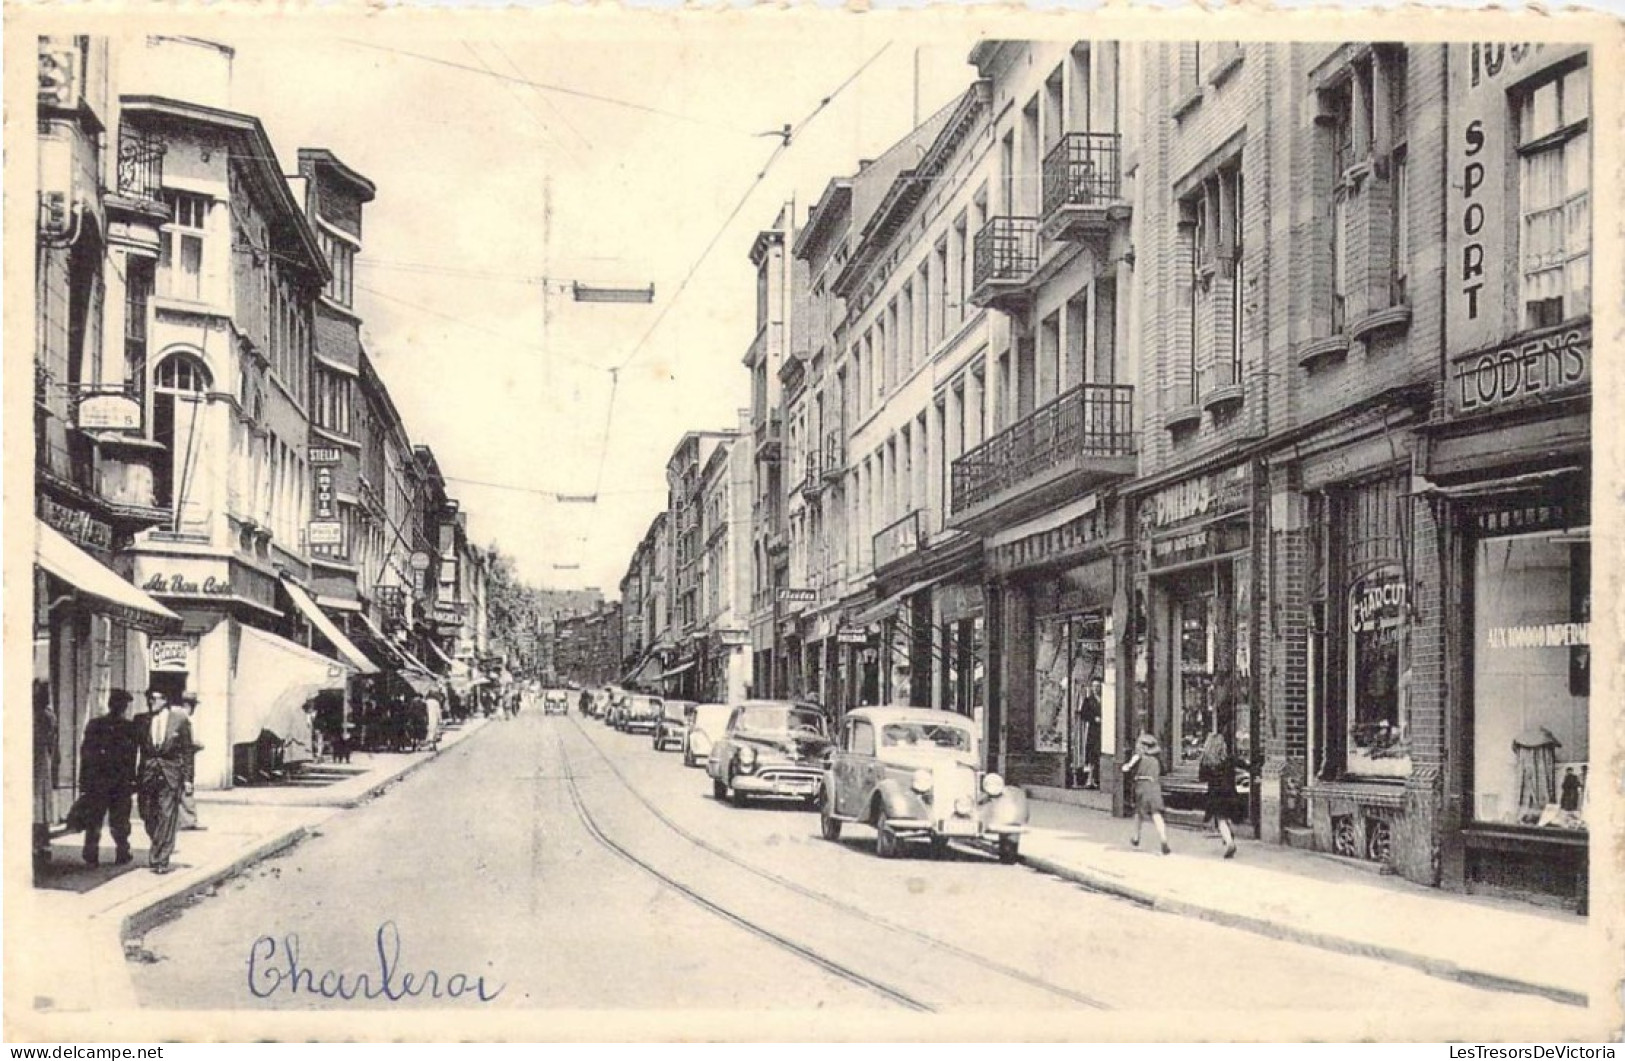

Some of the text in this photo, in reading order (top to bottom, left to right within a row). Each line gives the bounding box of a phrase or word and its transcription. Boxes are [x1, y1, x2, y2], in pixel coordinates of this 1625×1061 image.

[1463, 119, 1485, 320] SPORT
[1460, 330, 1585, 412] LODENS
[310, 448, 339, 461] STELLA
[319, 467, 331, 517] ARTOIS
[1487, 627, 1506, 649] AUX
[247, 919, 506, 1002] Charleroi
